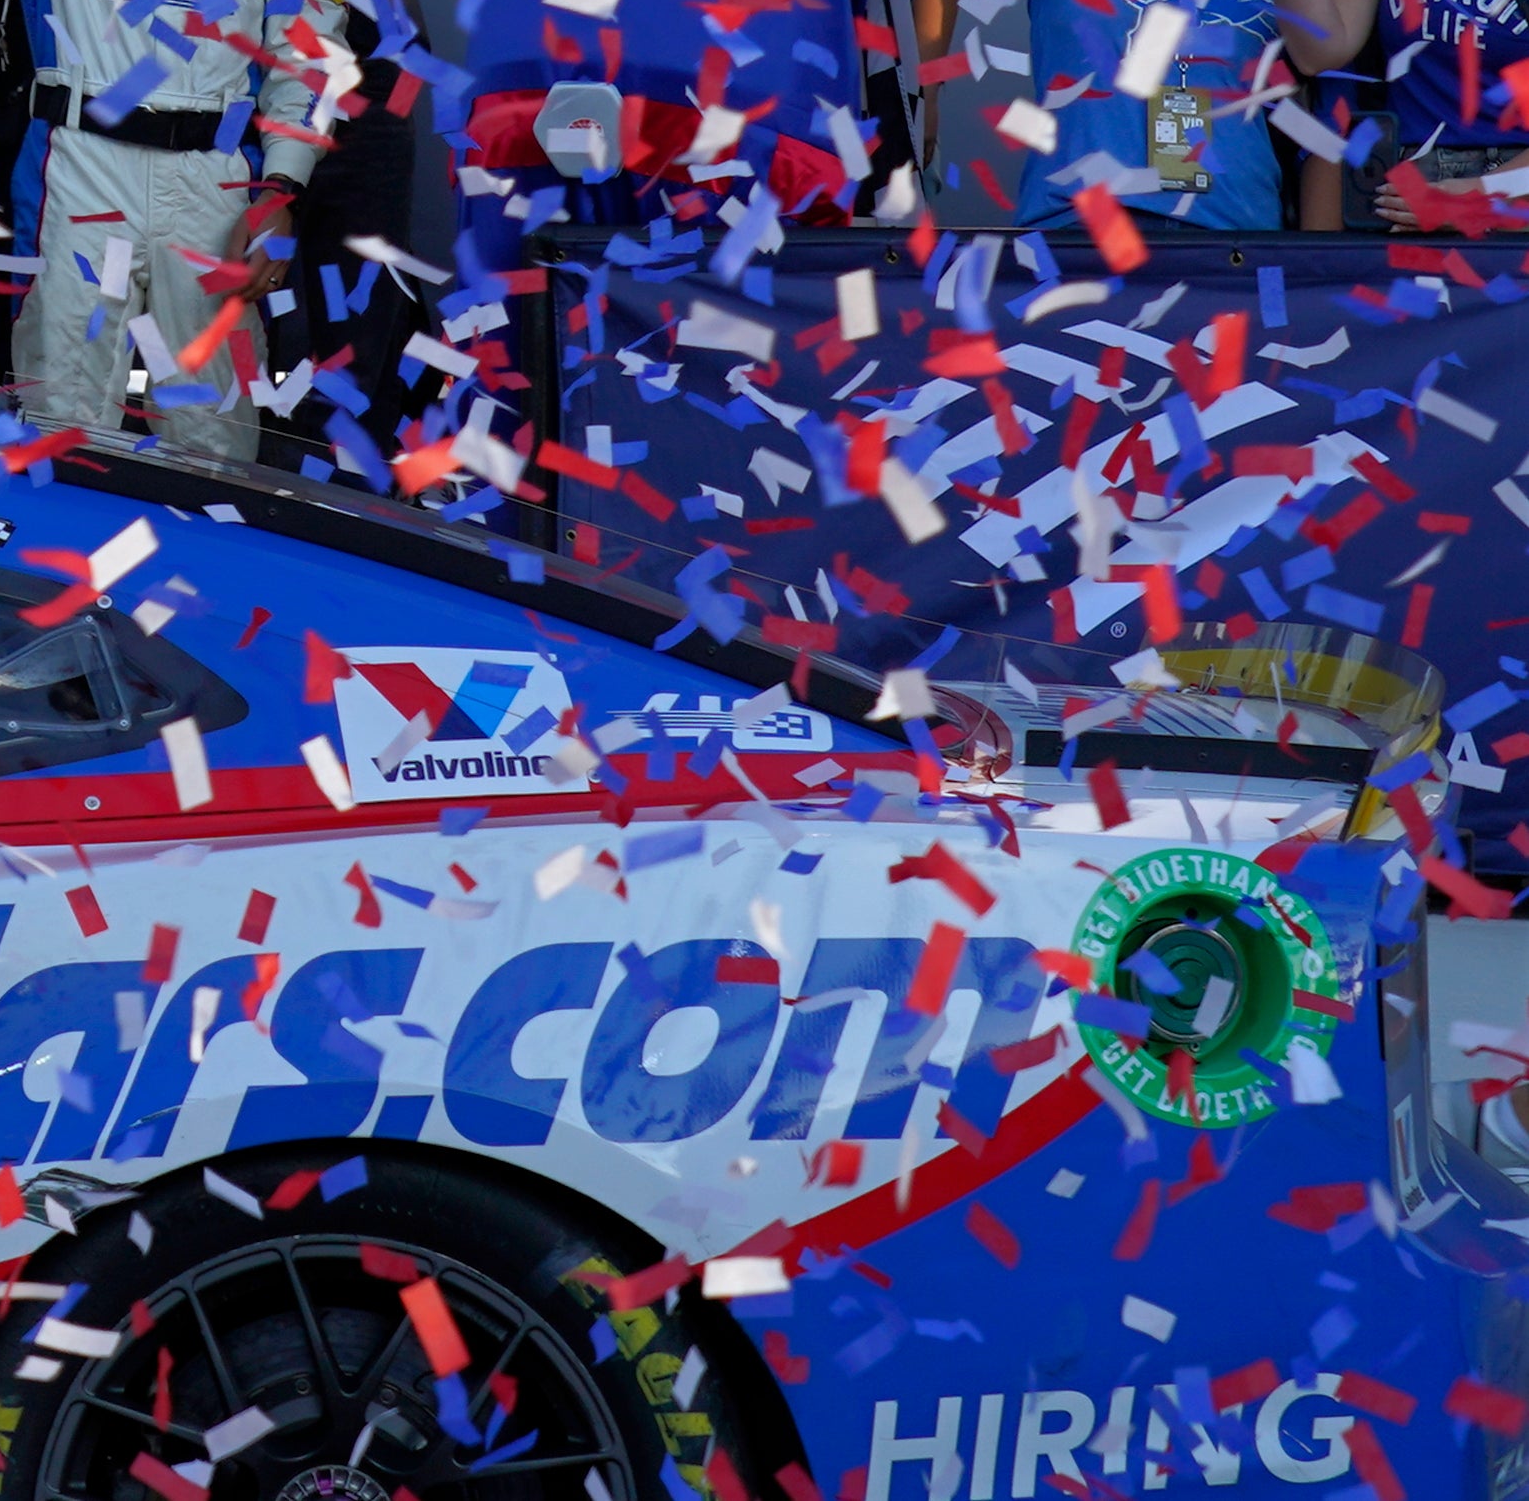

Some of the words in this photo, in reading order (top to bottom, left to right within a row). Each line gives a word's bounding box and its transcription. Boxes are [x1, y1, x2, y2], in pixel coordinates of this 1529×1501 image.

[1422, 7, 1489, 51] LIFE
[1078, 901, 1123, 960] GET
[1100, 1041, 1156, 1096] GET
[863, 1371, 1357, 1501] HIRING
